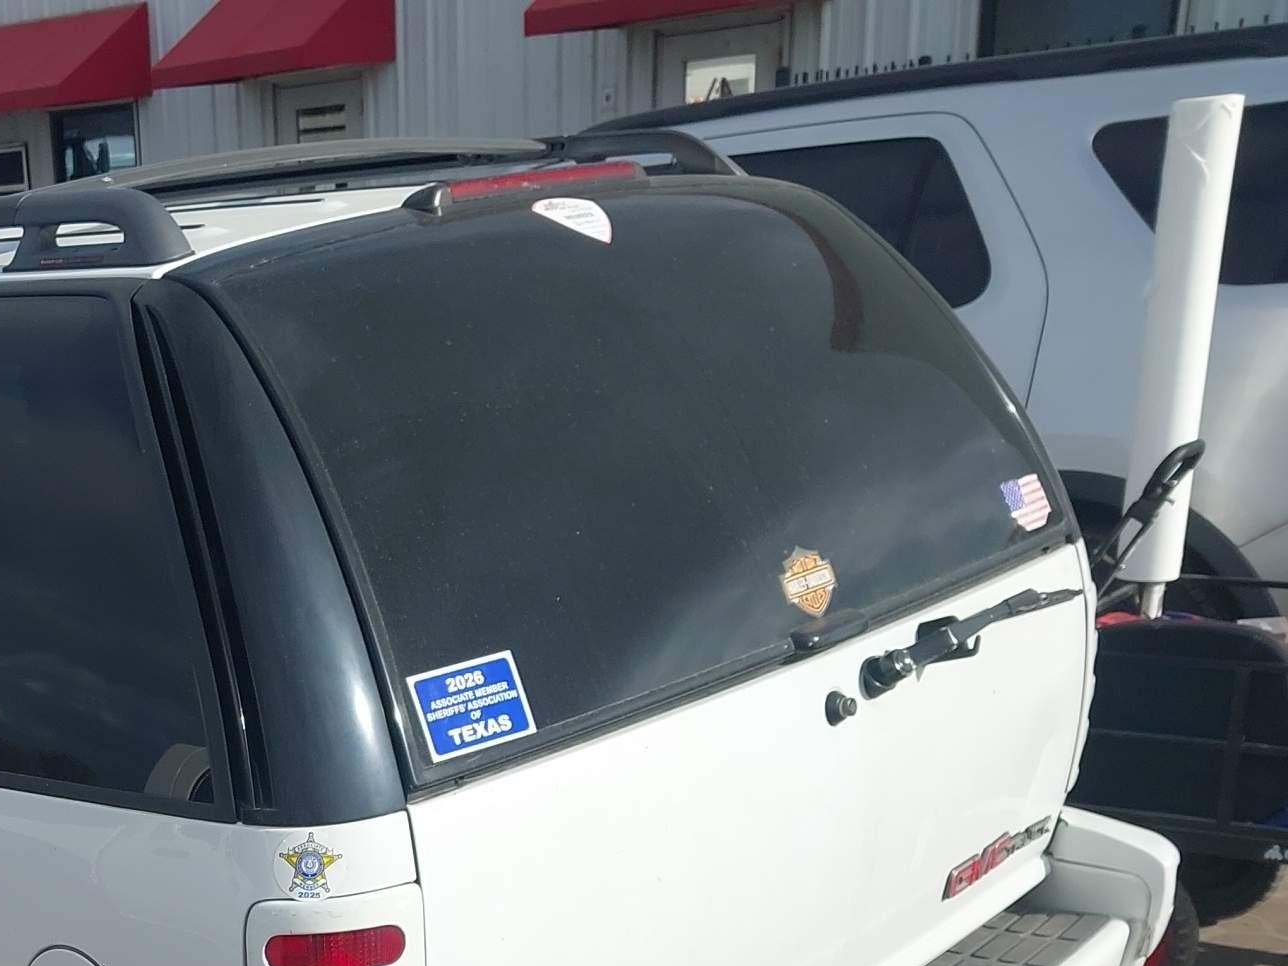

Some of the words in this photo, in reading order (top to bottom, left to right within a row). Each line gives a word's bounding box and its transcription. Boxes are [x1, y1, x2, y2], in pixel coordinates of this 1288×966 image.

[445, 670, 484, 693] 2026
[430, 691, 475, 710] ASSOCIATE
[475, 681, 509, 698] MEMBER
[467, 690, 518, 711] ASSOCIATION
[471, 710, 482, 720] OF
[448, 714, 512, 745] TEXAS
